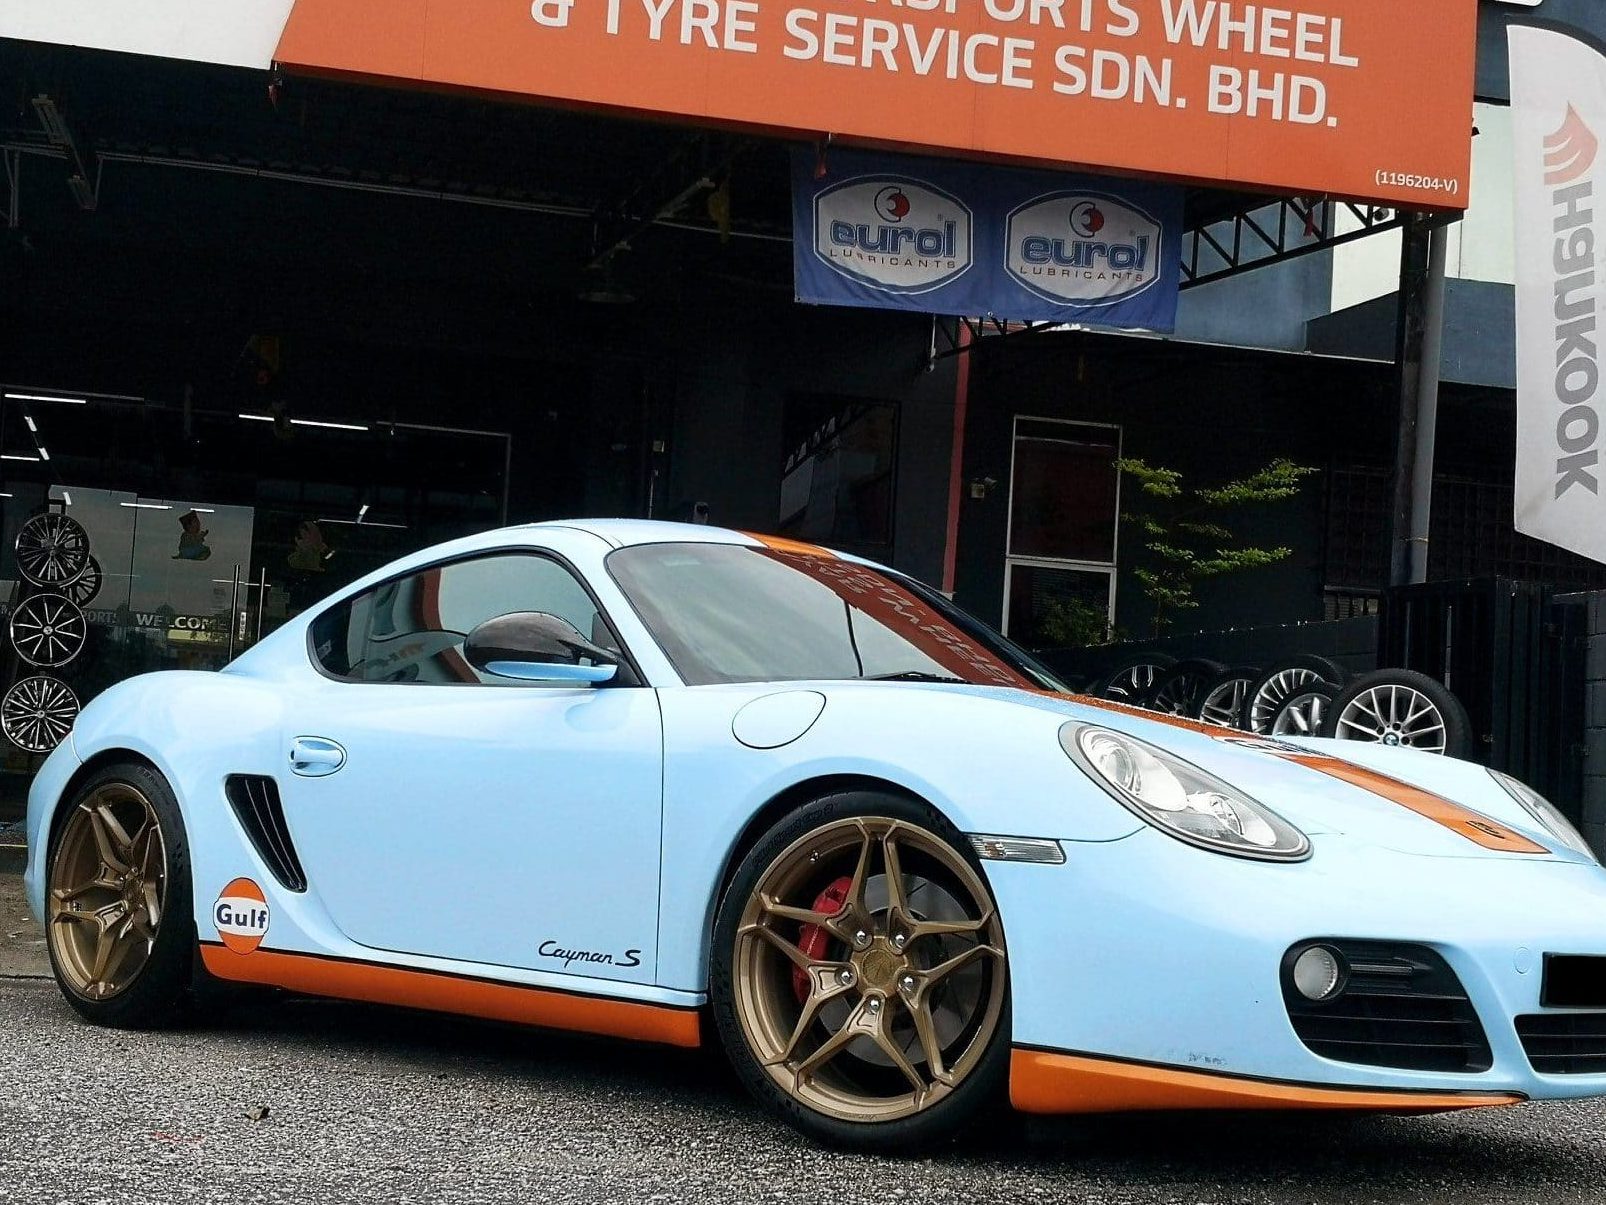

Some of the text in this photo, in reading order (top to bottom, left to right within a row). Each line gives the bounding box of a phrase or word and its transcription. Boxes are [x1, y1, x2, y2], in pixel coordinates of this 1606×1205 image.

[1159, 0, 1360, 68] WHEEL
[783, 8, 1035, 90] SERVICE
[1053, 44, 1187, 109] SDN.
[1207, 64, 1338, 128] BHD.
[1375, 169, 1458, 195] (1196204-V)
[830, 219, 957, 258] eurol
[1021, 236, 1150, 272] eurol
[1020, 266, 1143, 282] LUBRICANTS
[216, 903, 267, 929] Gulf
[538, 940, 641, 968] Cayman S
